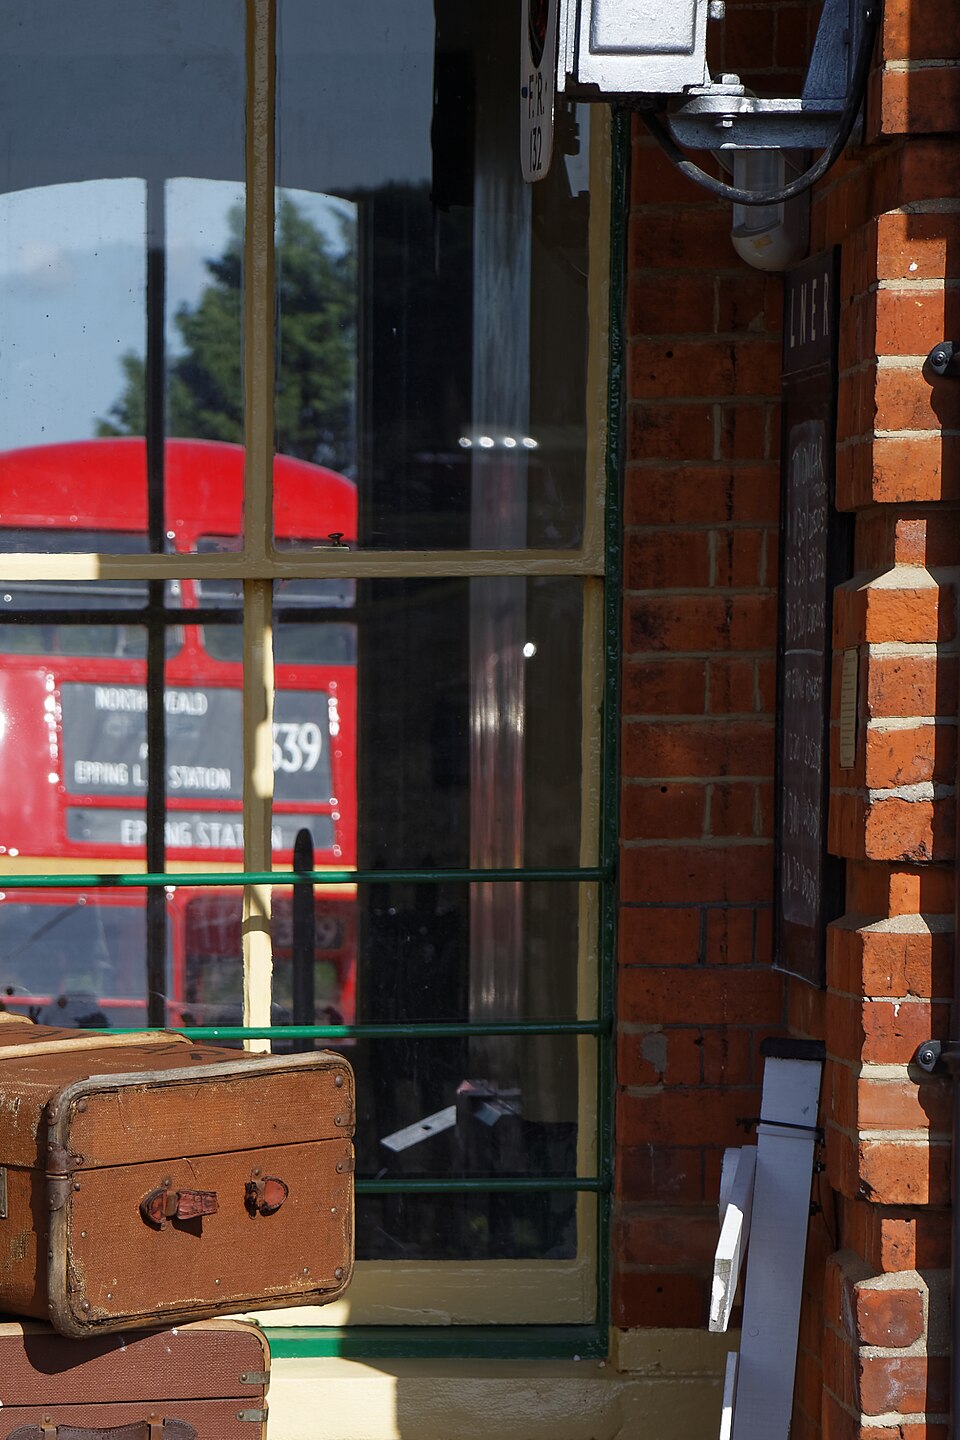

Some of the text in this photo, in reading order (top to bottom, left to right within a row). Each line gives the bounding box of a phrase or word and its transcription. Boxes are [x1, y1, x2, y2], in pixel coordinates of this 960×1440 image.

[528, 126, 542, 173] 132
[790, 272, 829, 349] LNER
[95, 687, 208, 716] NORTH EALD
[74, 760, 129, 786] EPPING
[168, 765, 231, 791] STATION
[121, 819, 283, 851] EPNG STATN
